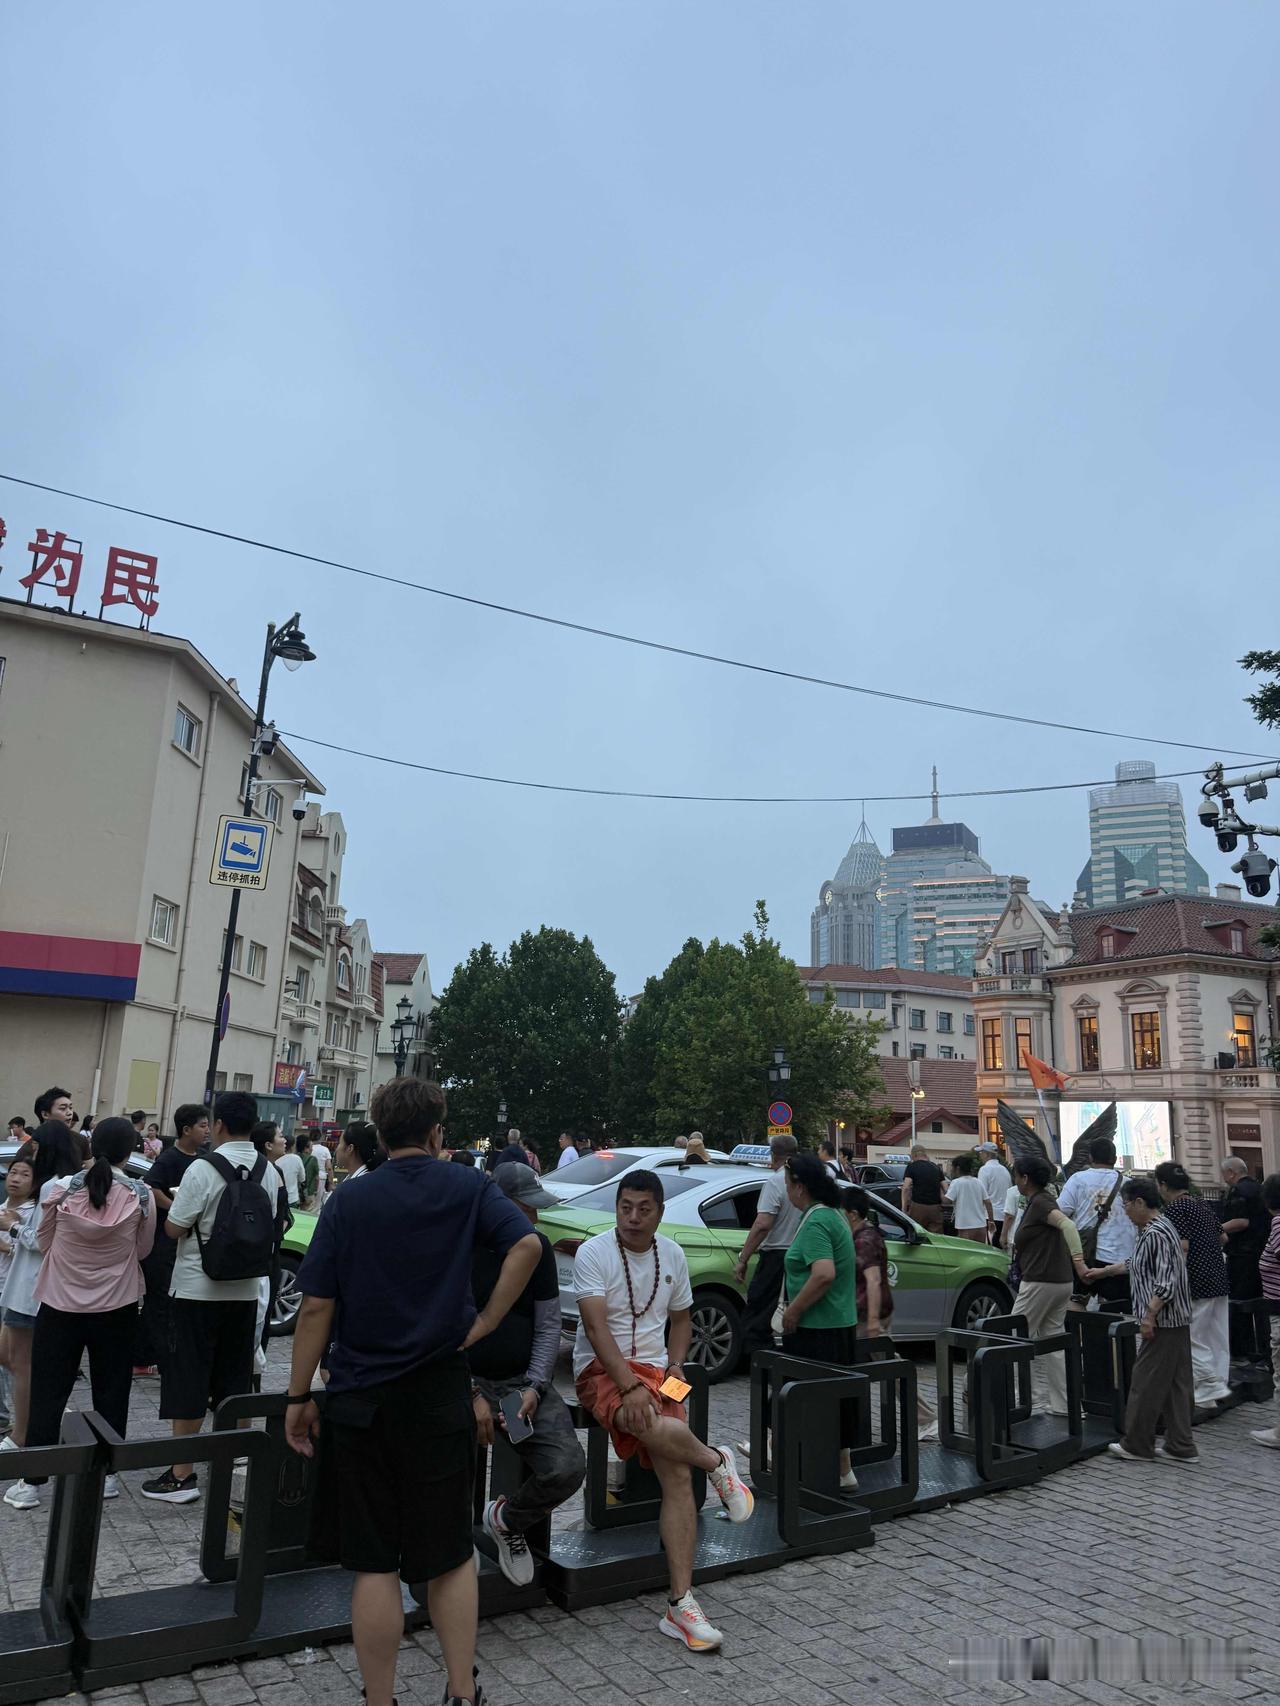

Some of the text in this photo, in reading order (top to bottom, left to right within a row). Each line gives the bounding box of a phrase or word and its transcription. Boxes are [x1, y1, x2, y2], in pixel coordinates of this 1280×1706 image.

[0, 517, 159, 617] 为民
[217, 871, 260, 885] 违停抓拍
[740, 1146, 770, 1154] TAXI
